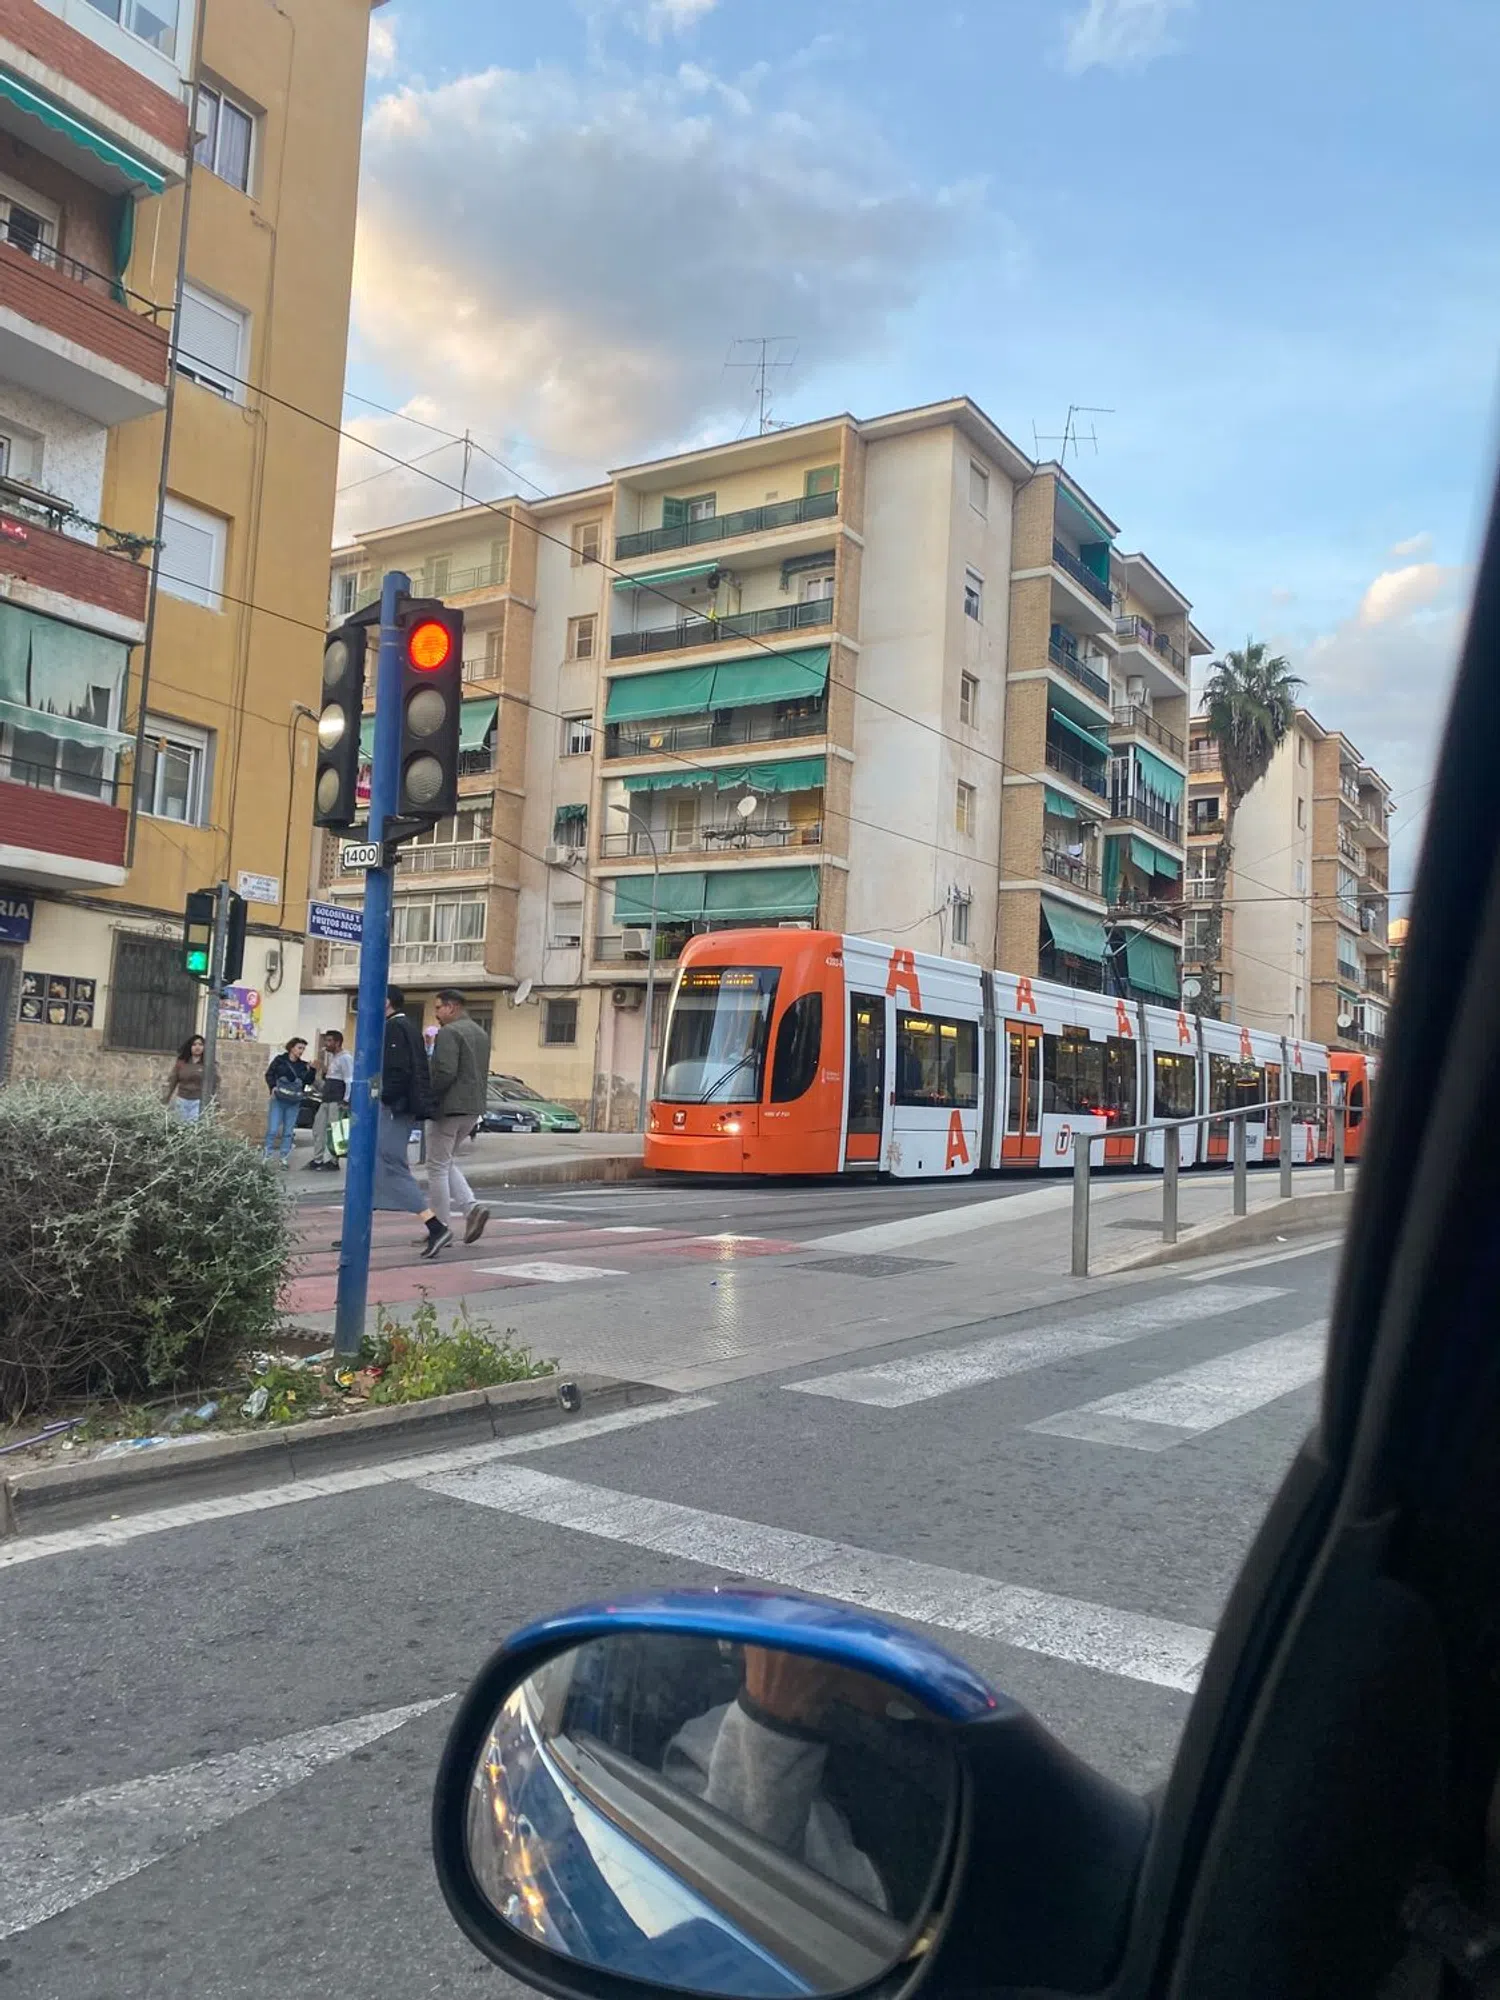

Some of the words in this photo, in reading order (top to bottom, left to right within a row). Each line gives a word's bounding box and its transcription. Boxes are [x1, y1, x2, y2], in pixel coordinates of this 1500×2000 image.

[345, 848, 376, 863] 1400
[312, 915, 340, 928] FRUTOS
[340, 921, 362, 932] SECOS
[320, 925, 353, 938] Vanesa
